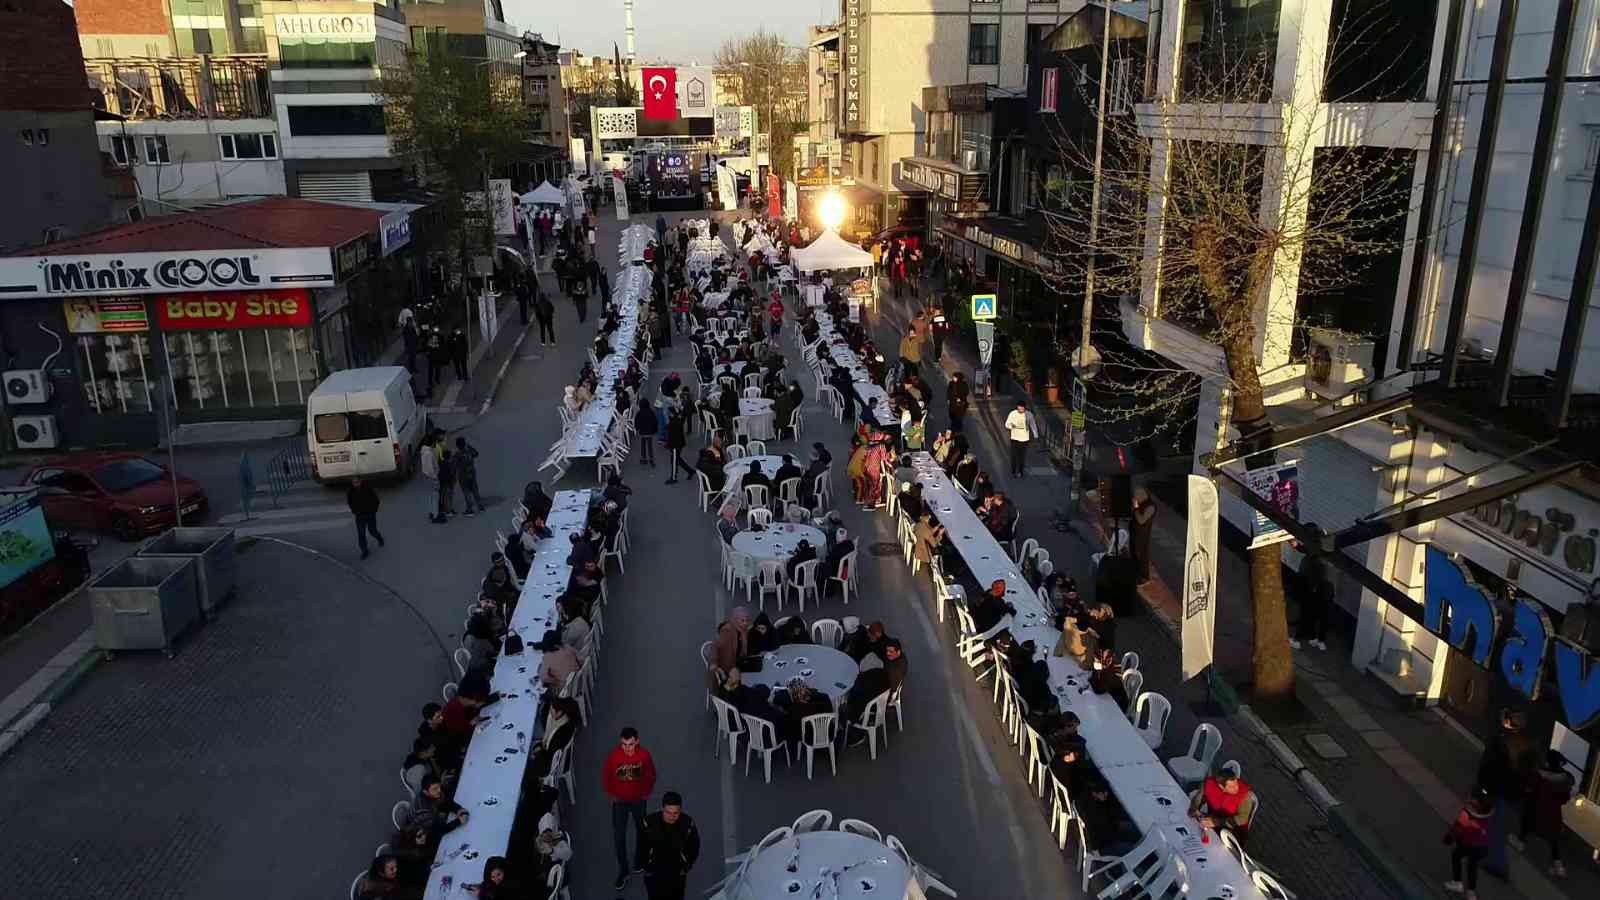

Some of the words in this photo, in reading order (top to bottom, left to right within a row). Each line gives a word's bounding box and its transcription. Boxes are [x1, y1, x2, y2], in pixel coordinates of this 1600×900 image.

[47, 259, 151, 292] Minix
[154, 256, 260, 287] COOL
[166, 299, 238, 321] Baby
[246, 294, 299, 317] She
